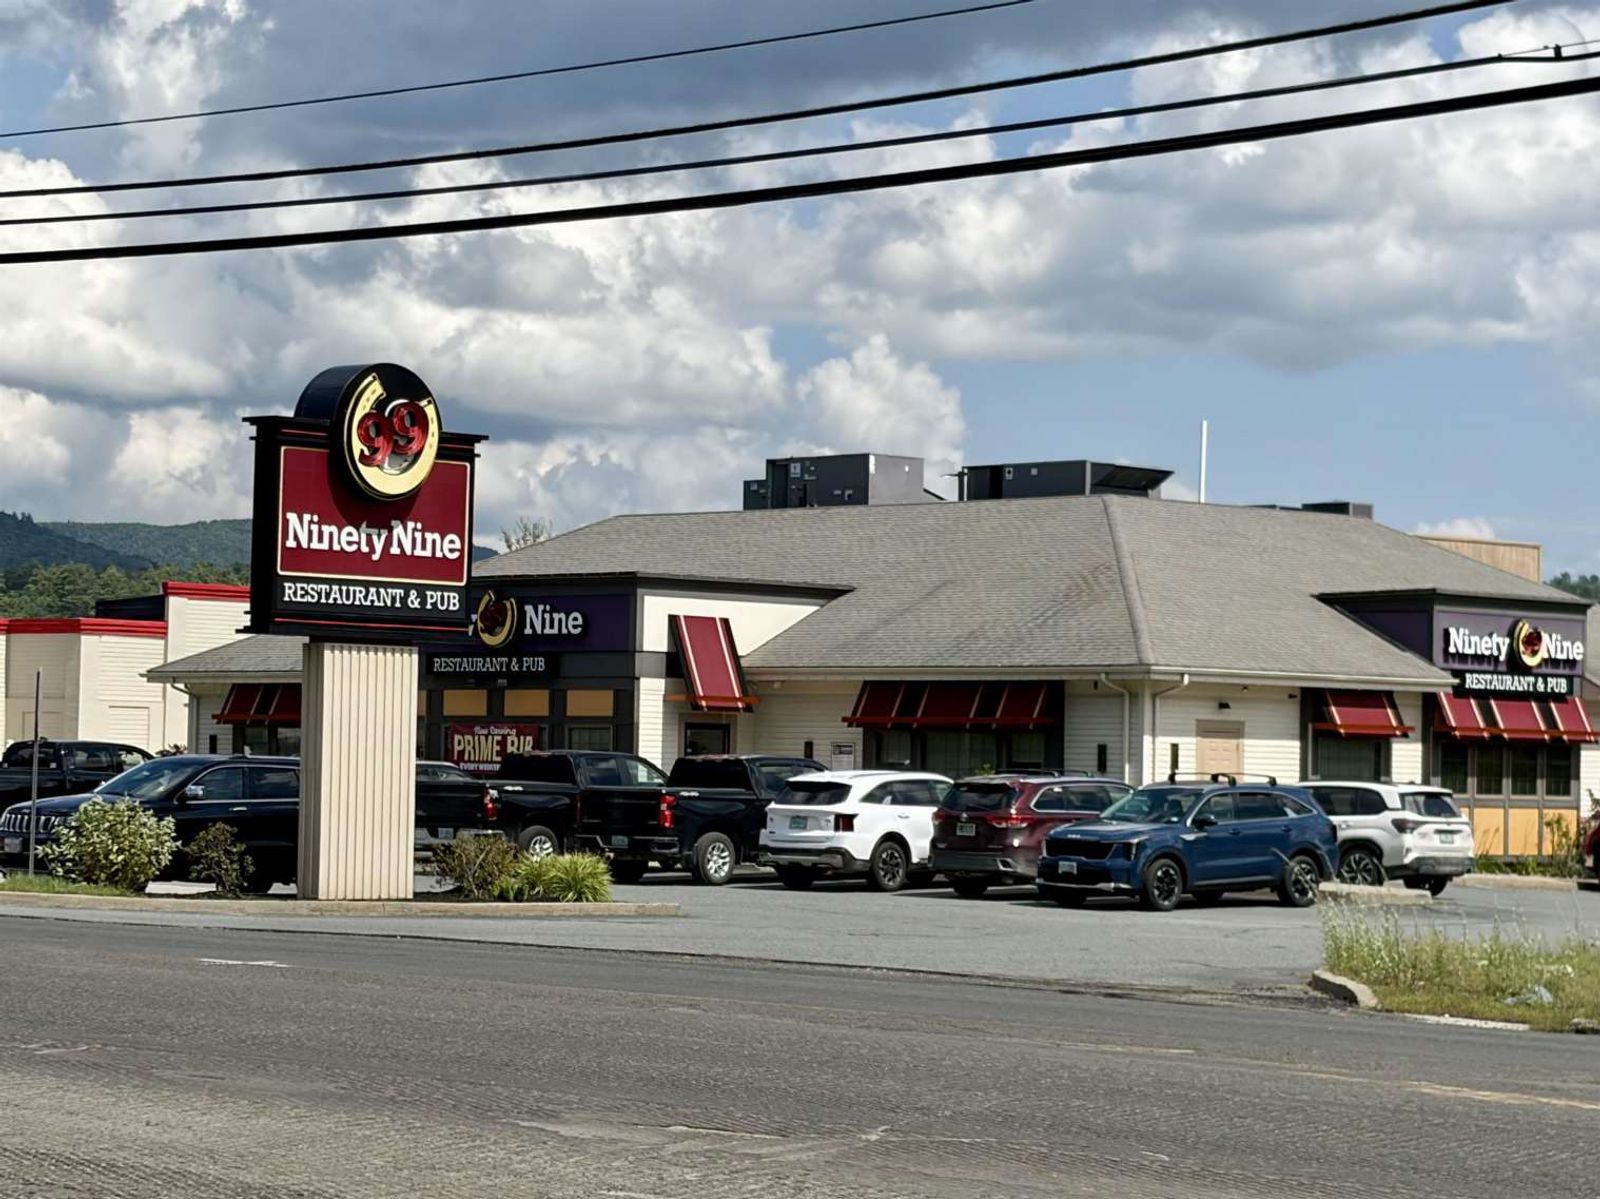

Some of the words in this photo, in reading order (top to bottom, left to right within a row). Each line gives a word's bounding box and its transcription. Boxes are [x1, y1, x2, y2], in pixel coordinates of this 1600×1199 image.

[357, 401, 430, 467] 99
[285, 511, 388, 561] Ninety
[390, 520, 462, 560] Nine
[283, 582, 404, 607] RESTAURANT
[407, 590, 421, 609] &
[425, 591, 460, 610] PUB
[523, 604, 583, 635] Nine
[1448, 626, 1510, 661] Ninety
[1540, 632, 1584, 661] Nine
[433, 657, 508, 672] RESTAURANT
[510, 659, 519, 671] &
[522, 657, 545, 671] PUB
[1465, 673, 1535, 692] RESTAURANT
[1536, 679, 1545, 692] &
[1547, 680, 1568, 693] PUB
[454, 734, 502, 762] PRIME
